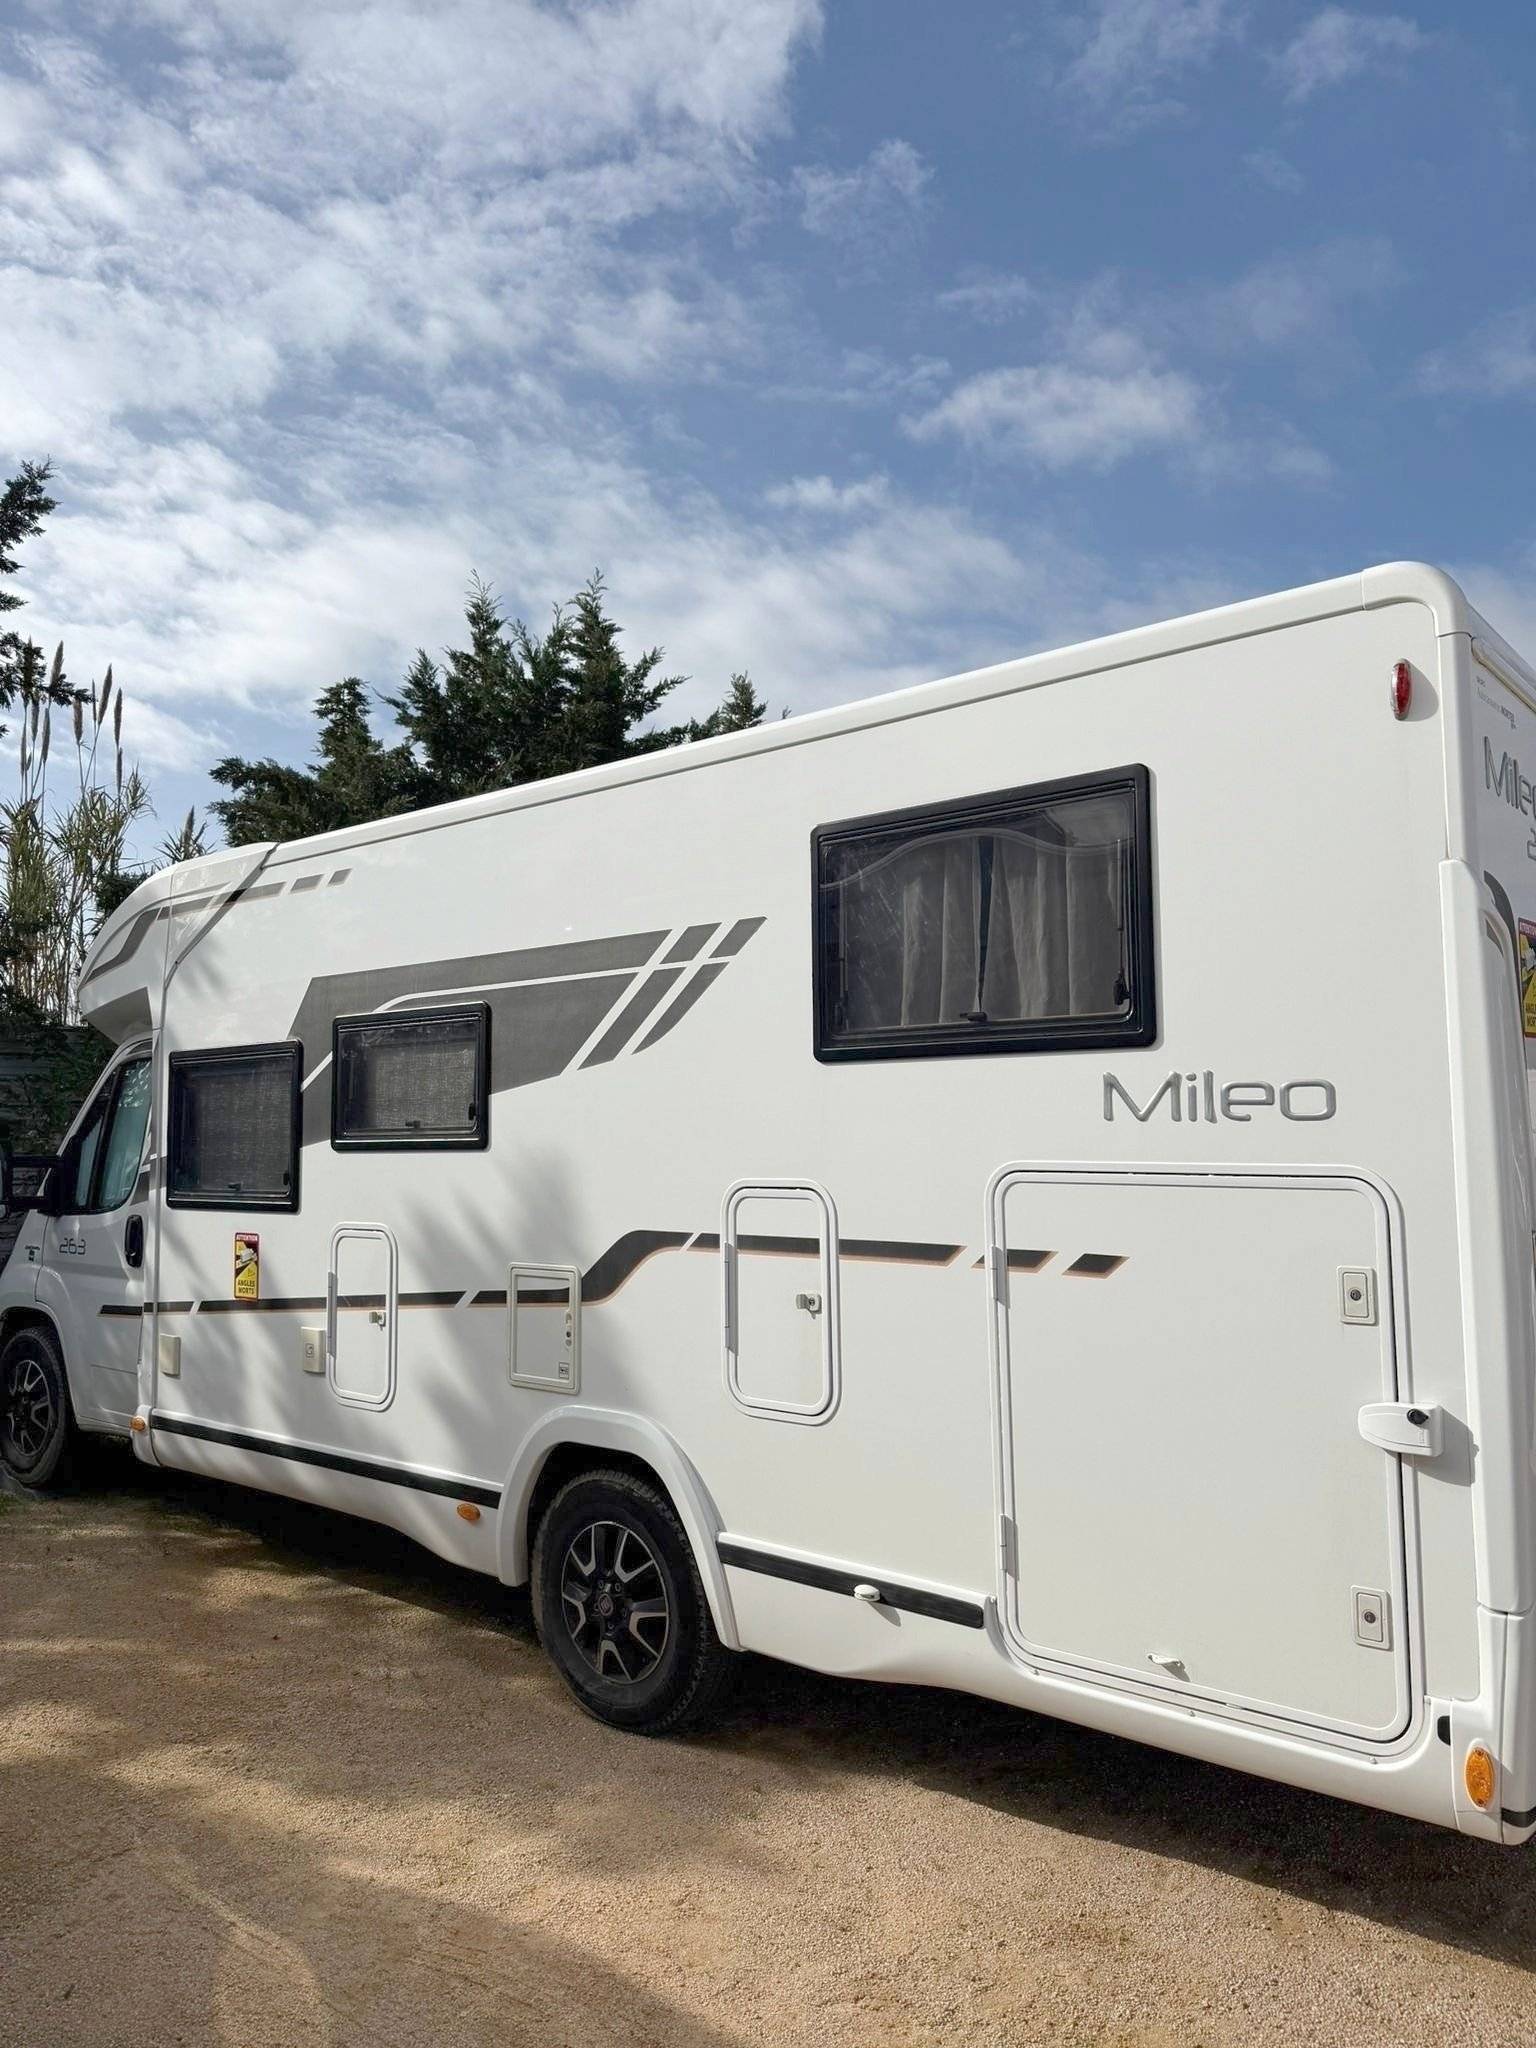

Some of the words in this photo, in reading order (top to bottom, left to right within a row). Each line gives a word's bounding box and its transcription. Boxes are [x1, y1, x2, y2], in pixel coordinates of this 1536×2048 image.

[1484, 736, 1536, 821] Mile
[1103, 1070, 1337, 1123] Mileo
[59, 1238, 86, 1255] 263
